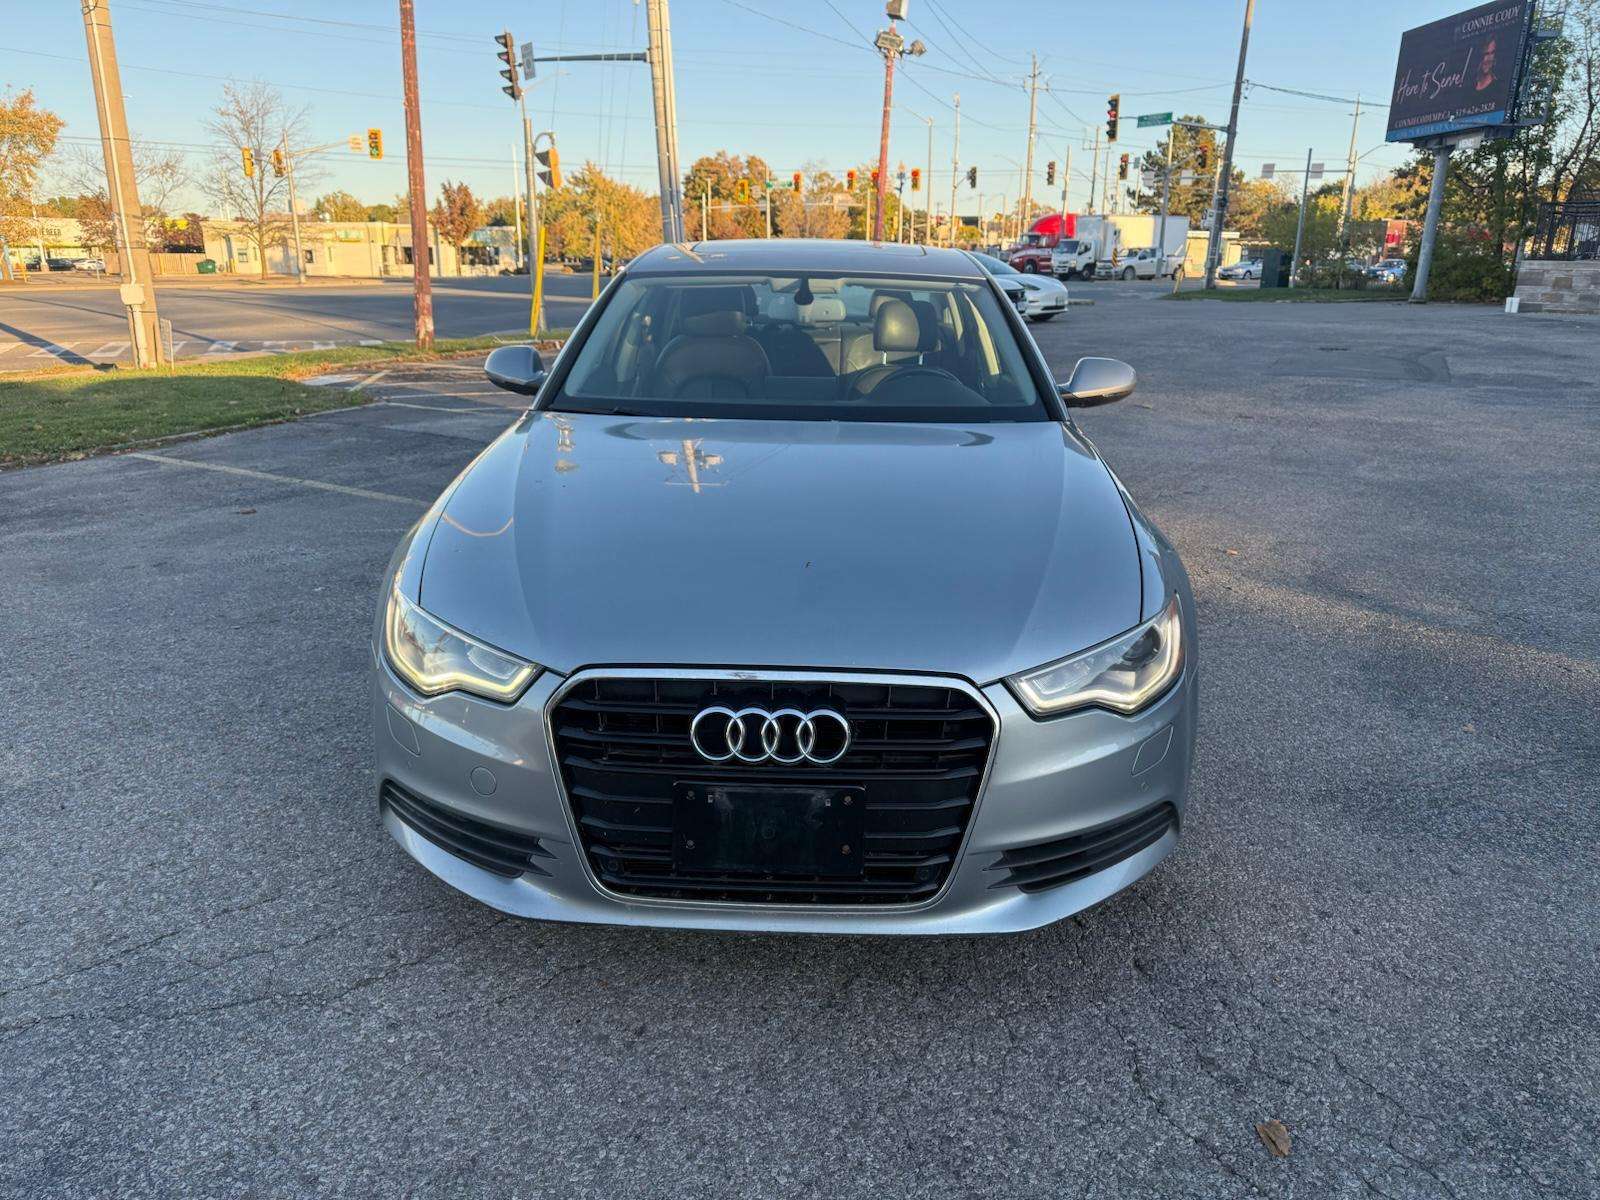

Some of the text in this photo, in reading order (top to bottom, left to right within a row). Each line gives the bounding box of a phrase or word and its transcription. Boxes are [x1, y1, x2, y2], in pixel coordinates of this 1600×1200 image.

[1462, 13, 1494, 33] CONNIE
[1494, 5, 1521, 23] CODY
[1395, 47, 1473, 104] Here to Serve!
